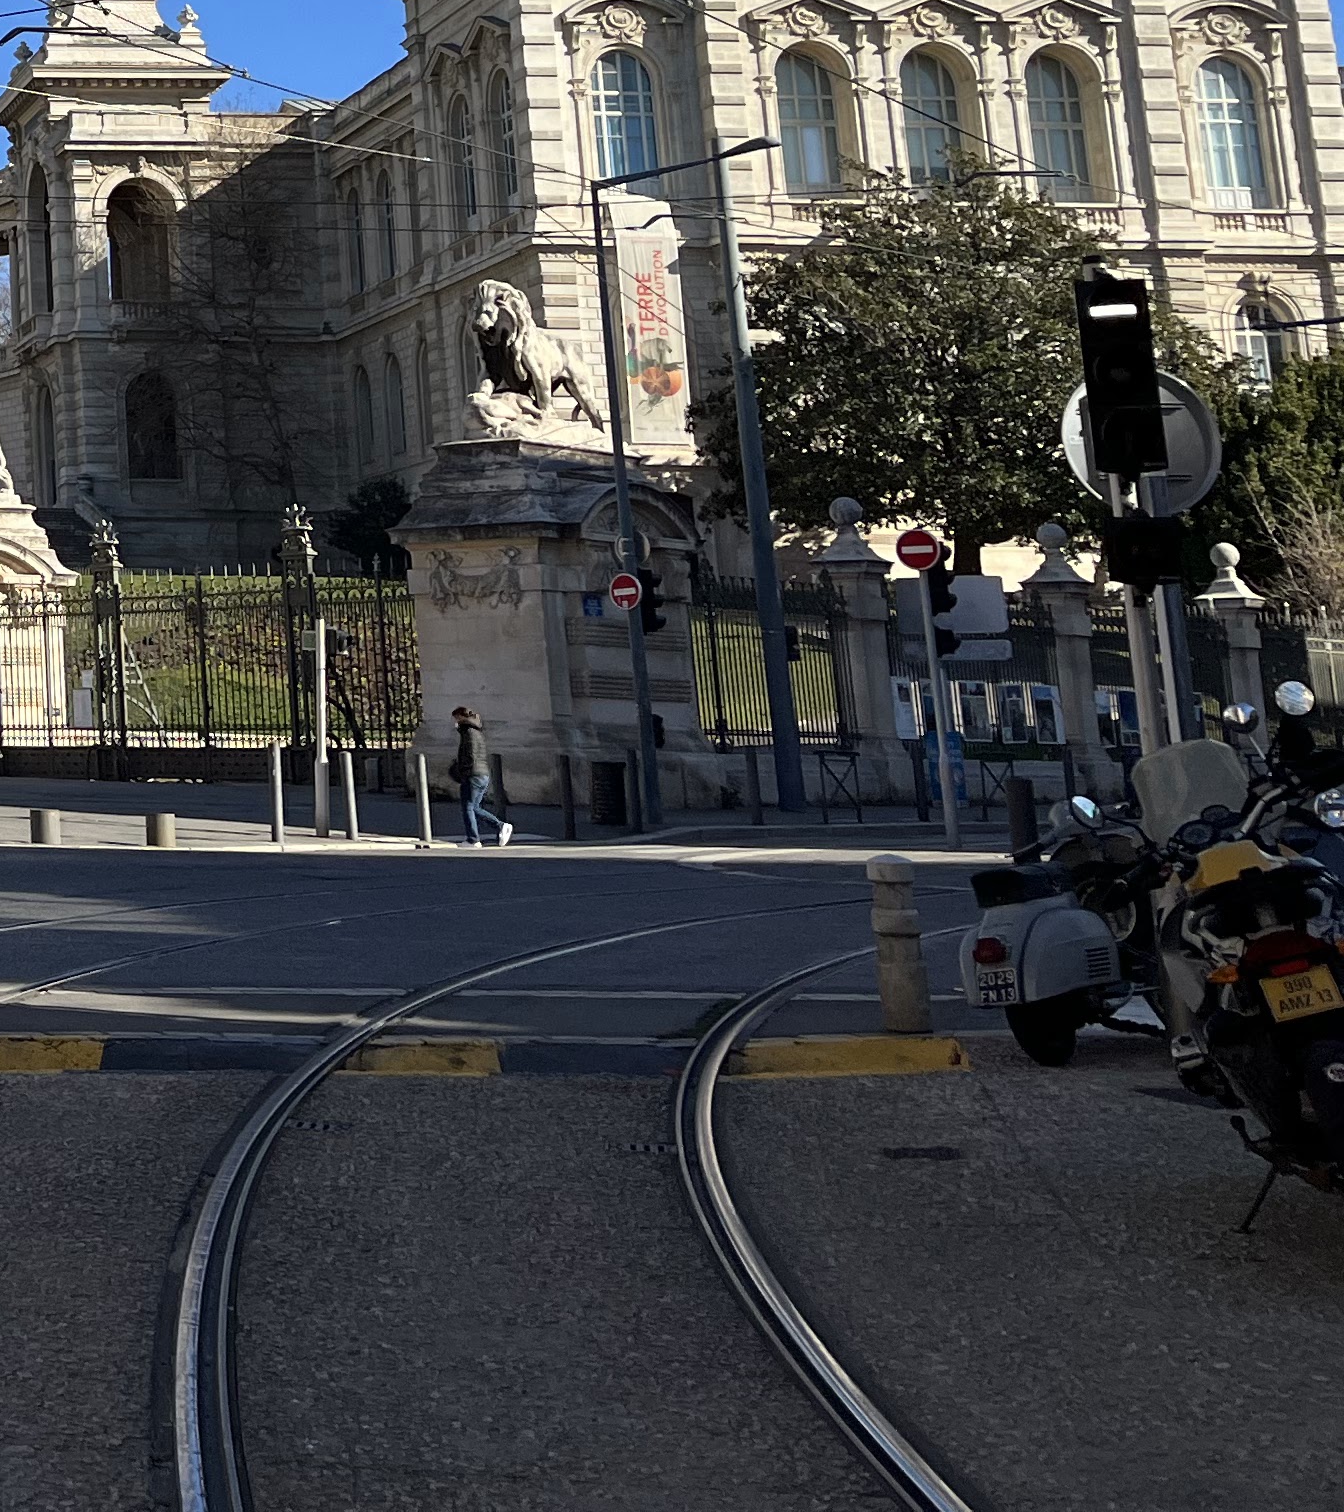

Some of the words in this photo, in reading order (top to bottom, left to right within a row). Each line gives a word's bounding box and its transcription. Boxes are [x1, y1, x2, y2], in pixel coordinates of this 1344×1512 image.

[636, 273, 655, 336] TERRE
[980, 989, 998, 1003] FN
[1000, 987, 1016, 1001] 13
